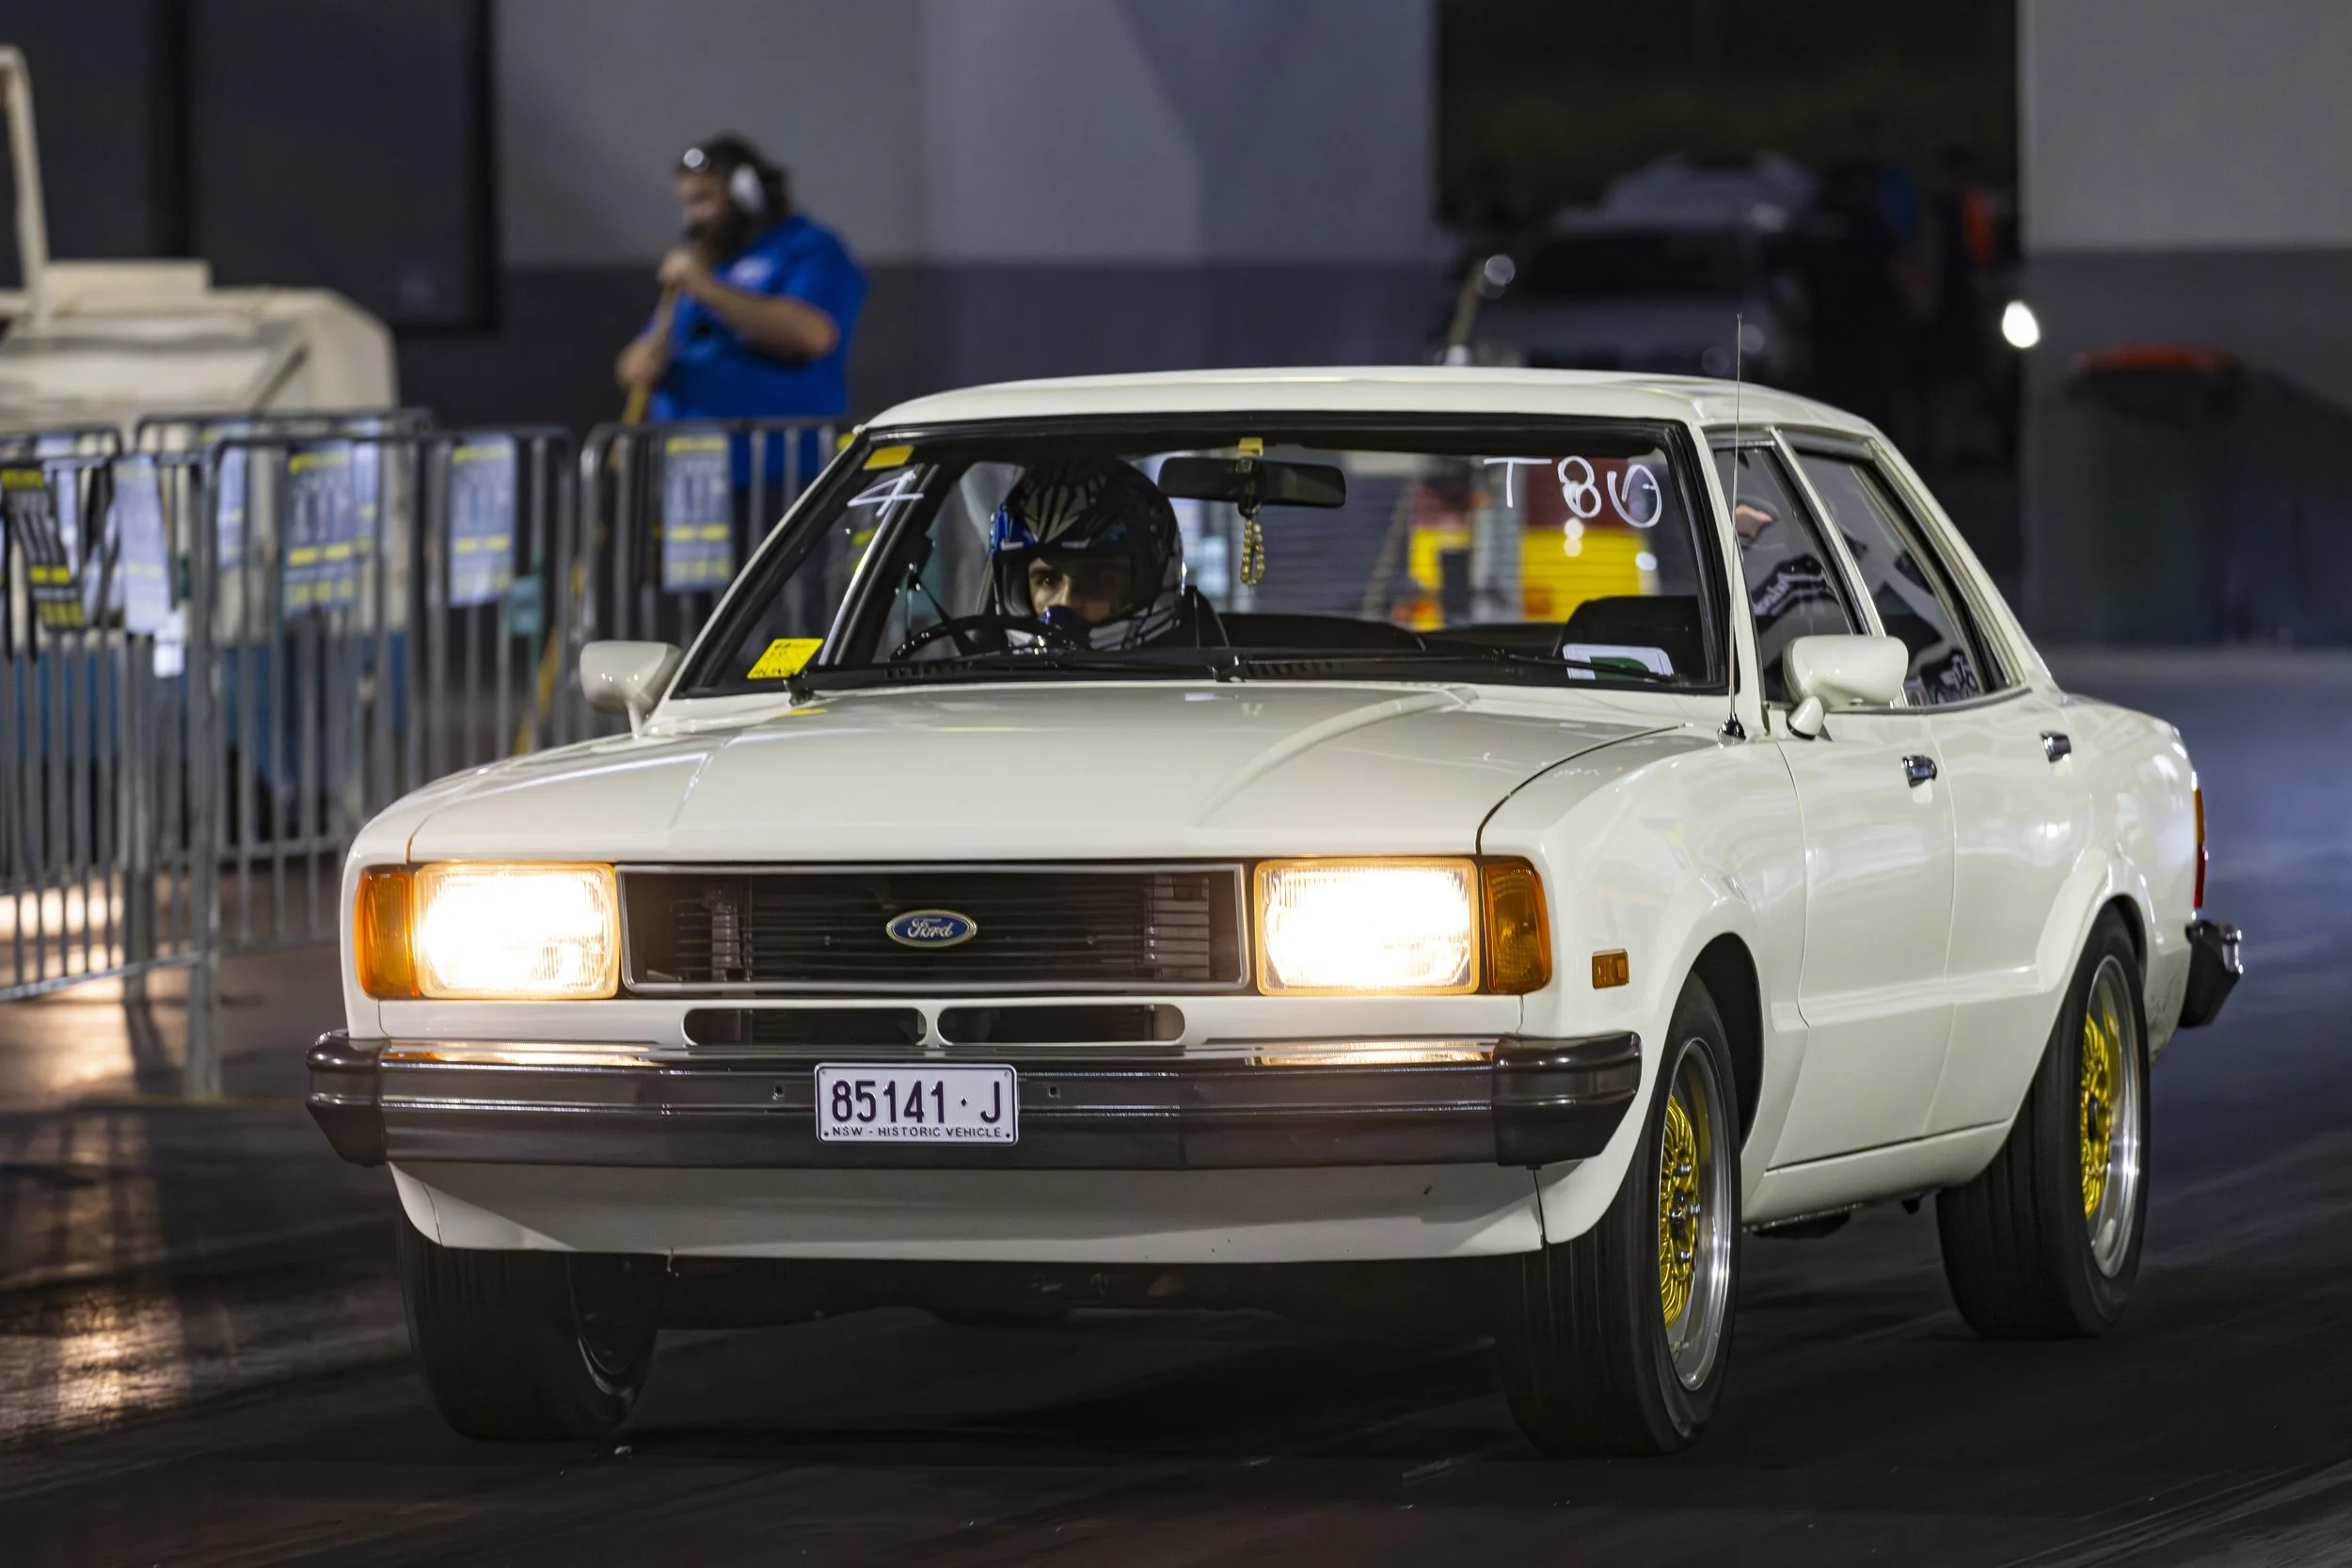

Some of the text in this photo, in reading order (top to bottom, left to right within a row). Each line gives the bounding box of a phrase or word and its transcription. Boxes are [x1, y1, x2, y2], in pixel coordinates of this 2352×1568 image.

[847, 469, 925, 517] 4
[907, 918, 954, 938] Ford
[833, 1127, 864, 1137] NSW
[878, 1127, 941, 1137] HISTORIC
[946, 1127, 1002, 1138] VEHICLE
